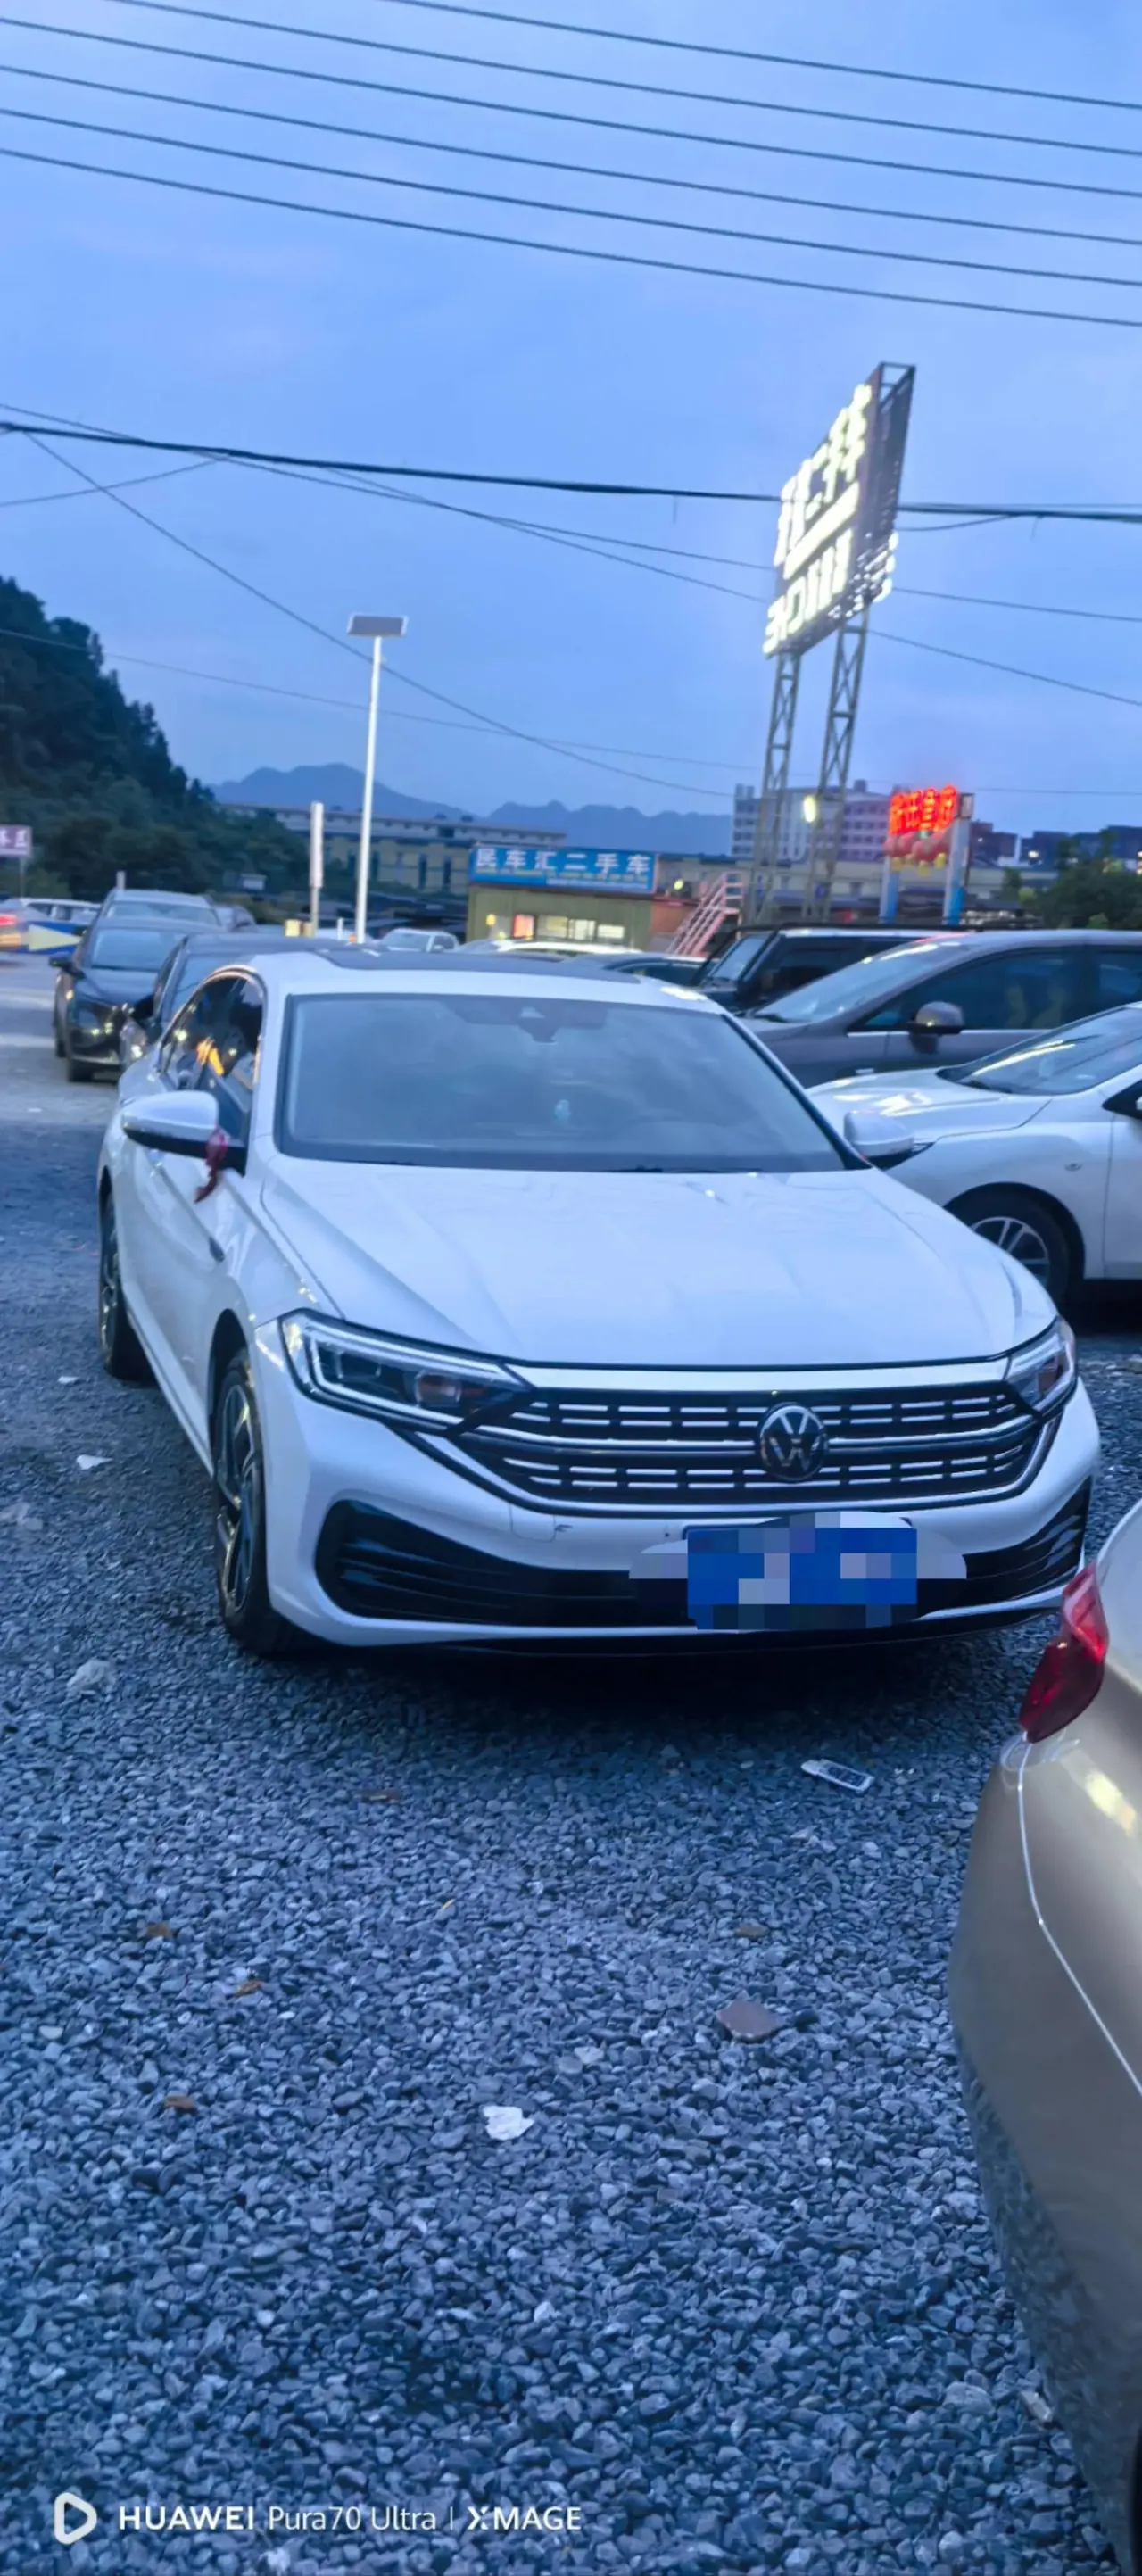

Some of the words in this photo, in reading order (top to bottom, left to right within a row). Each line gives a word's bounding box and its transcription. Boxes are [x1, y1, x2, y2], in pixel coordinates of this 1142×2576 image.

[476, 847, 651, 879] 民车汇二手车
